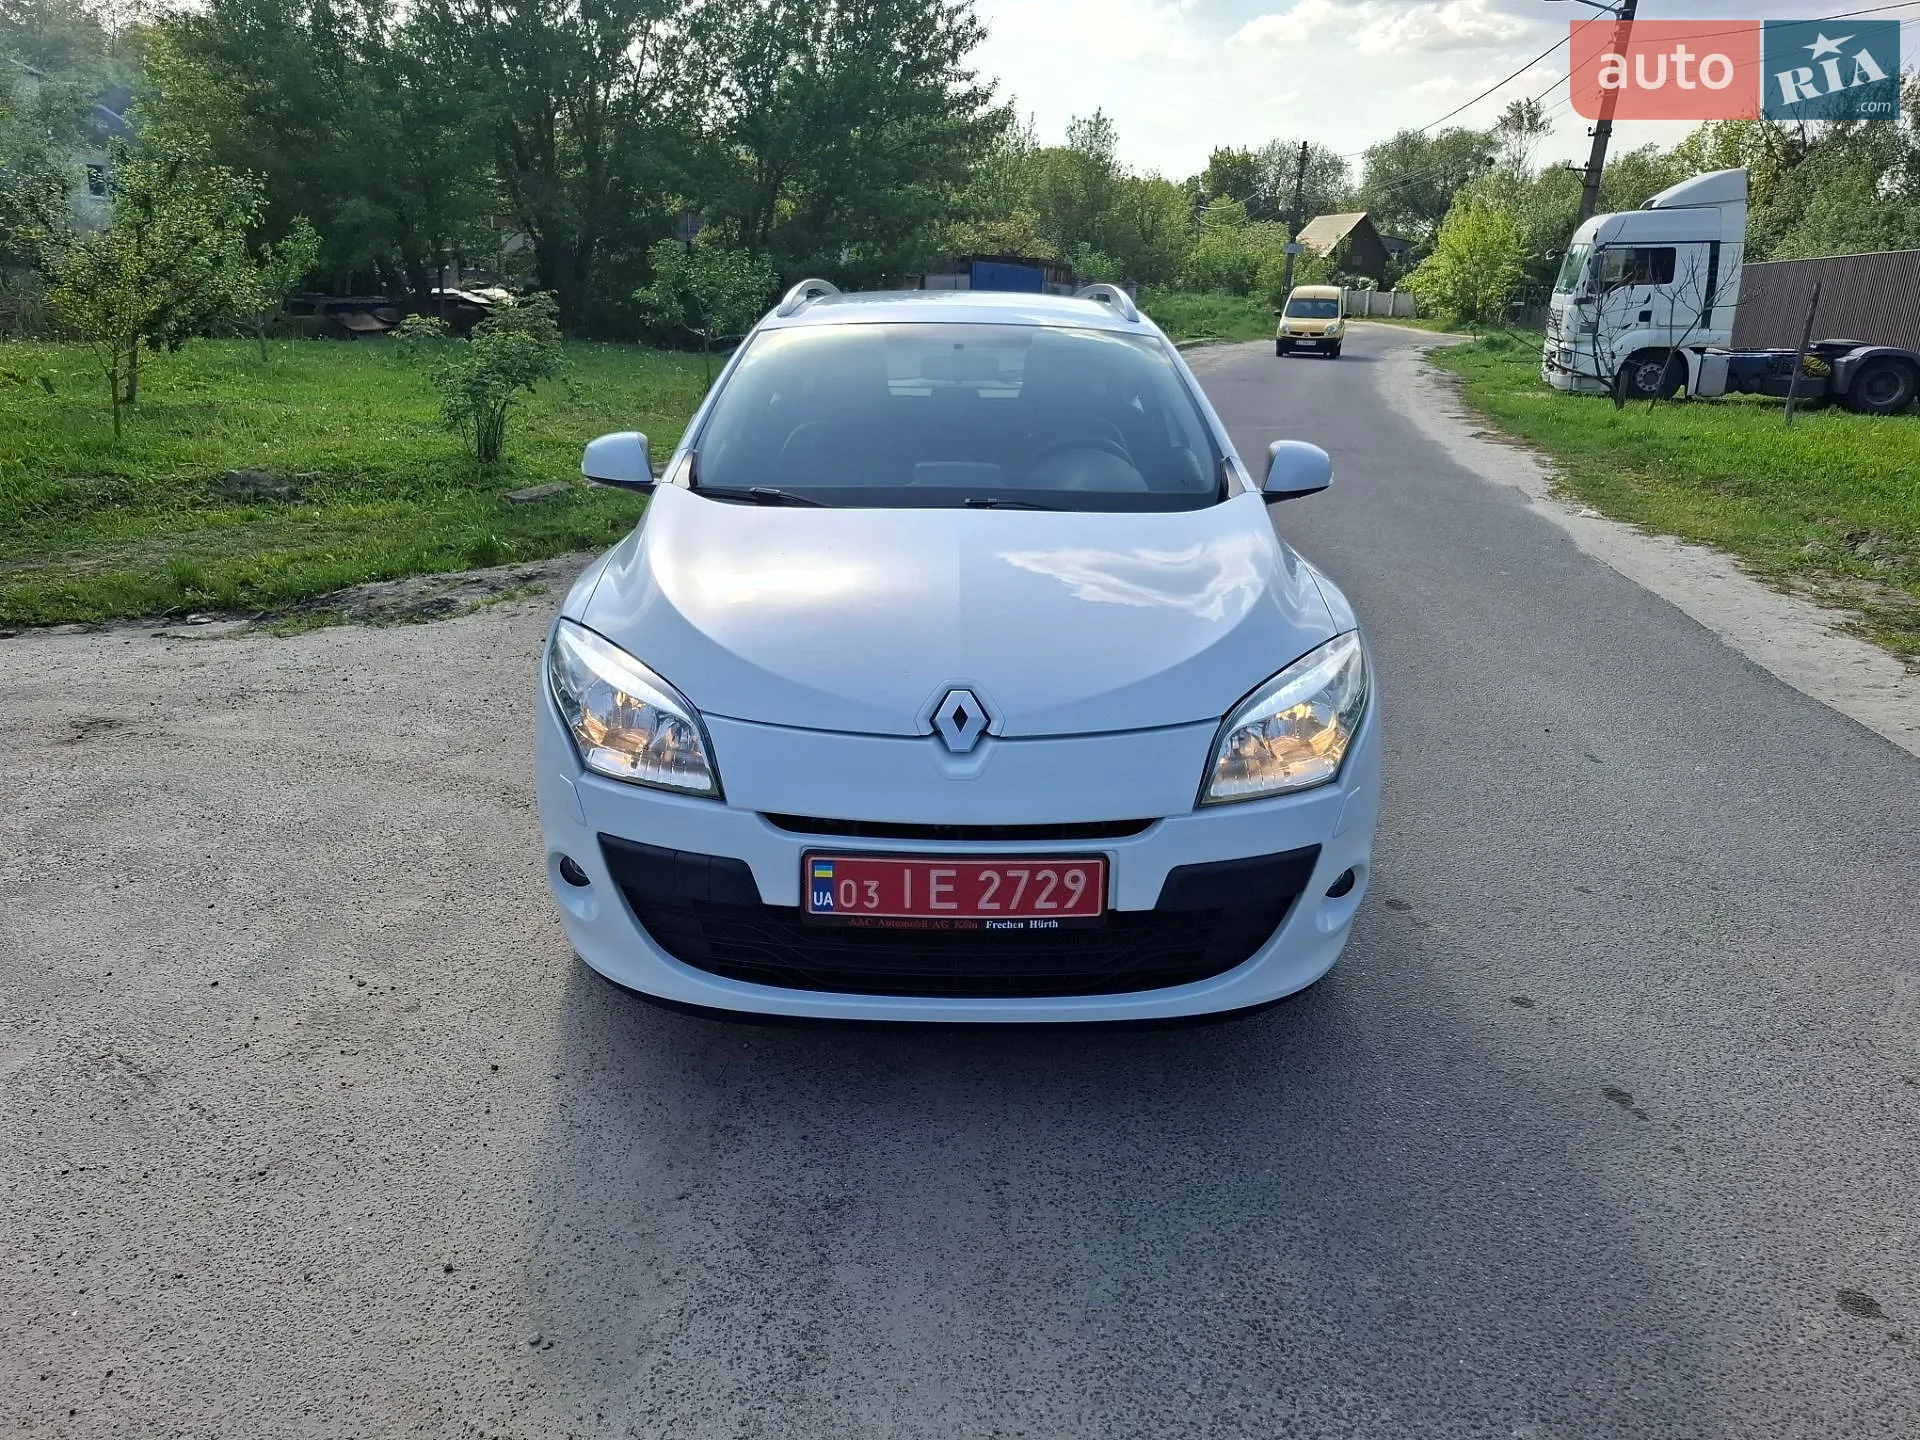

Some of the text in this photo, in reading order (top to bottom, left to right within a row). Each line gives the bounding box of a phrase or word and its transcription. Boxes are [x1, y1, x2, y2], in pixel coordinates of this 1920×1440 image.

[840, 868, 1087, 910] 03 IE 2729
[813, 891, 834, 906] UA
[933, 919, 949, 929] AG
[985, 920, 1024, 929] Frechen
[1029, 919, 1059, 929] Hürth
